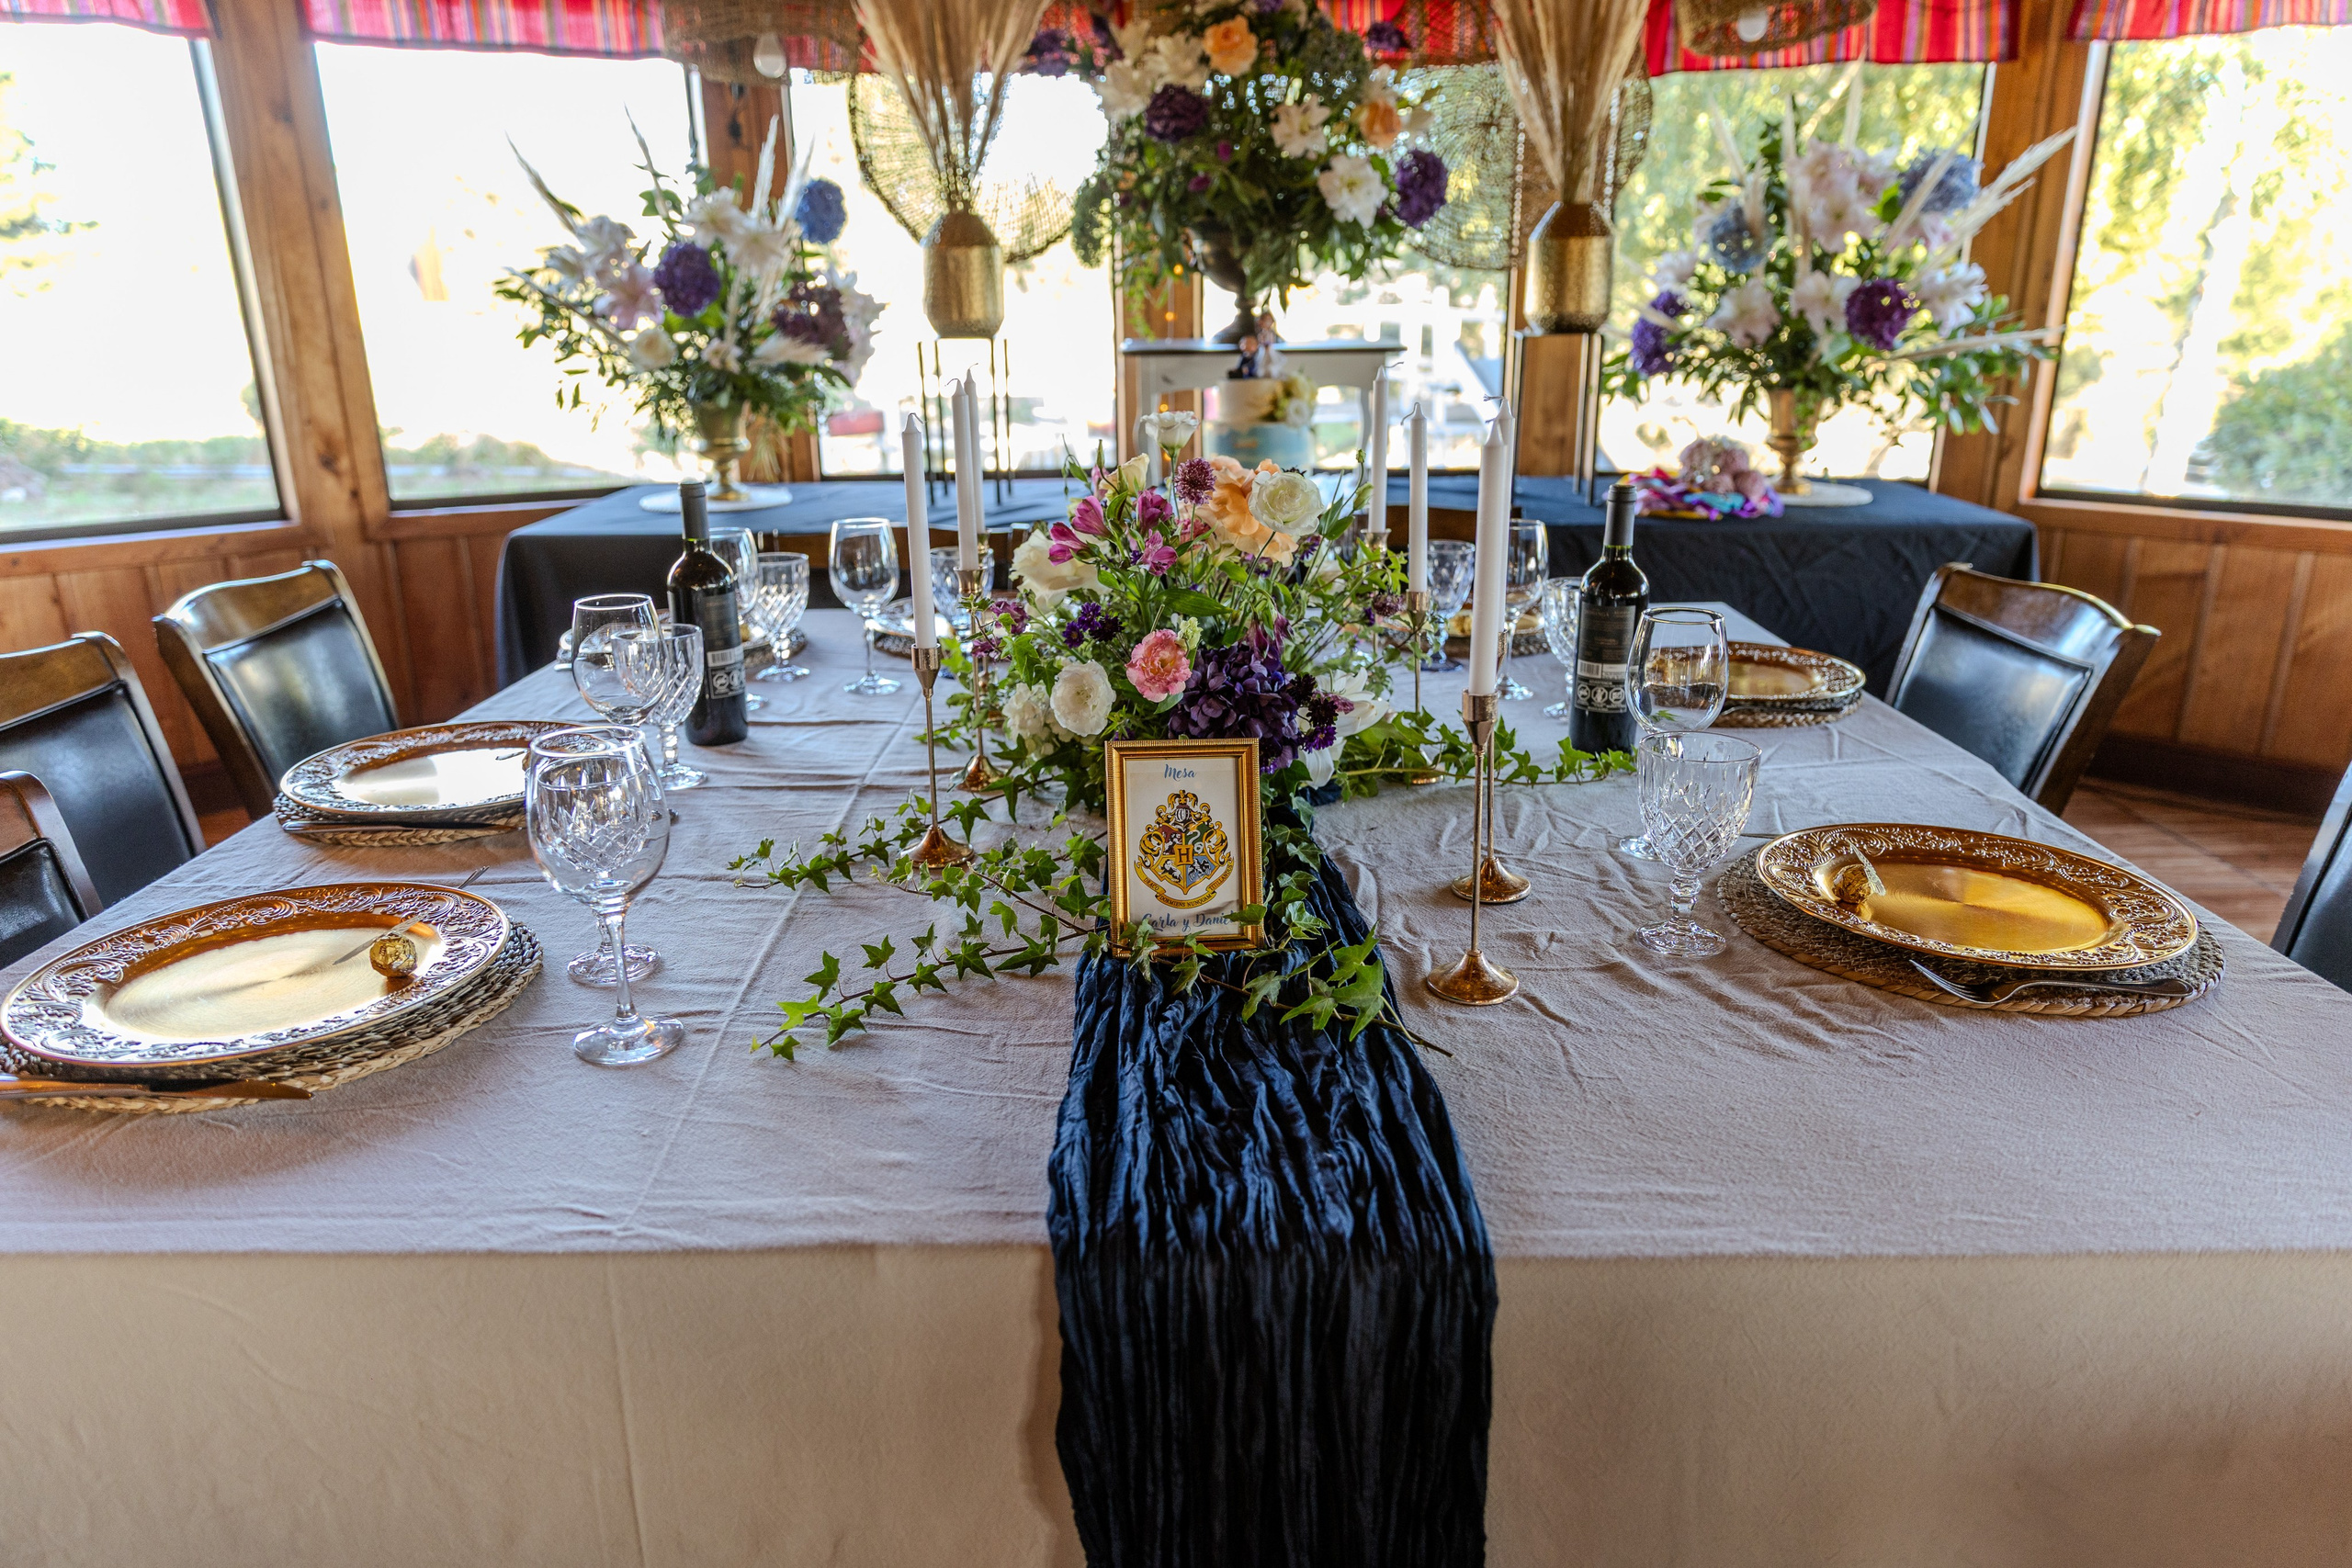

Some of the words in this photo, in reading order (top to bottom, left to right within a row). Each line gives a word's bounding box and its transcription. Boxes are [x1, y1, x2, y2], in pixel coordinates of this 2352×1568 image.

[1164, 763, 1196, 782] Mesa
[1177, 847, 1191, 863] H
[1143, 877, 1159, 891] DRACO
[1159, 895, 1186, 908] DORMIENS
[1187, 893, 1212, 908] NUNQUAM
[1182, 918, 1191, 932] y
